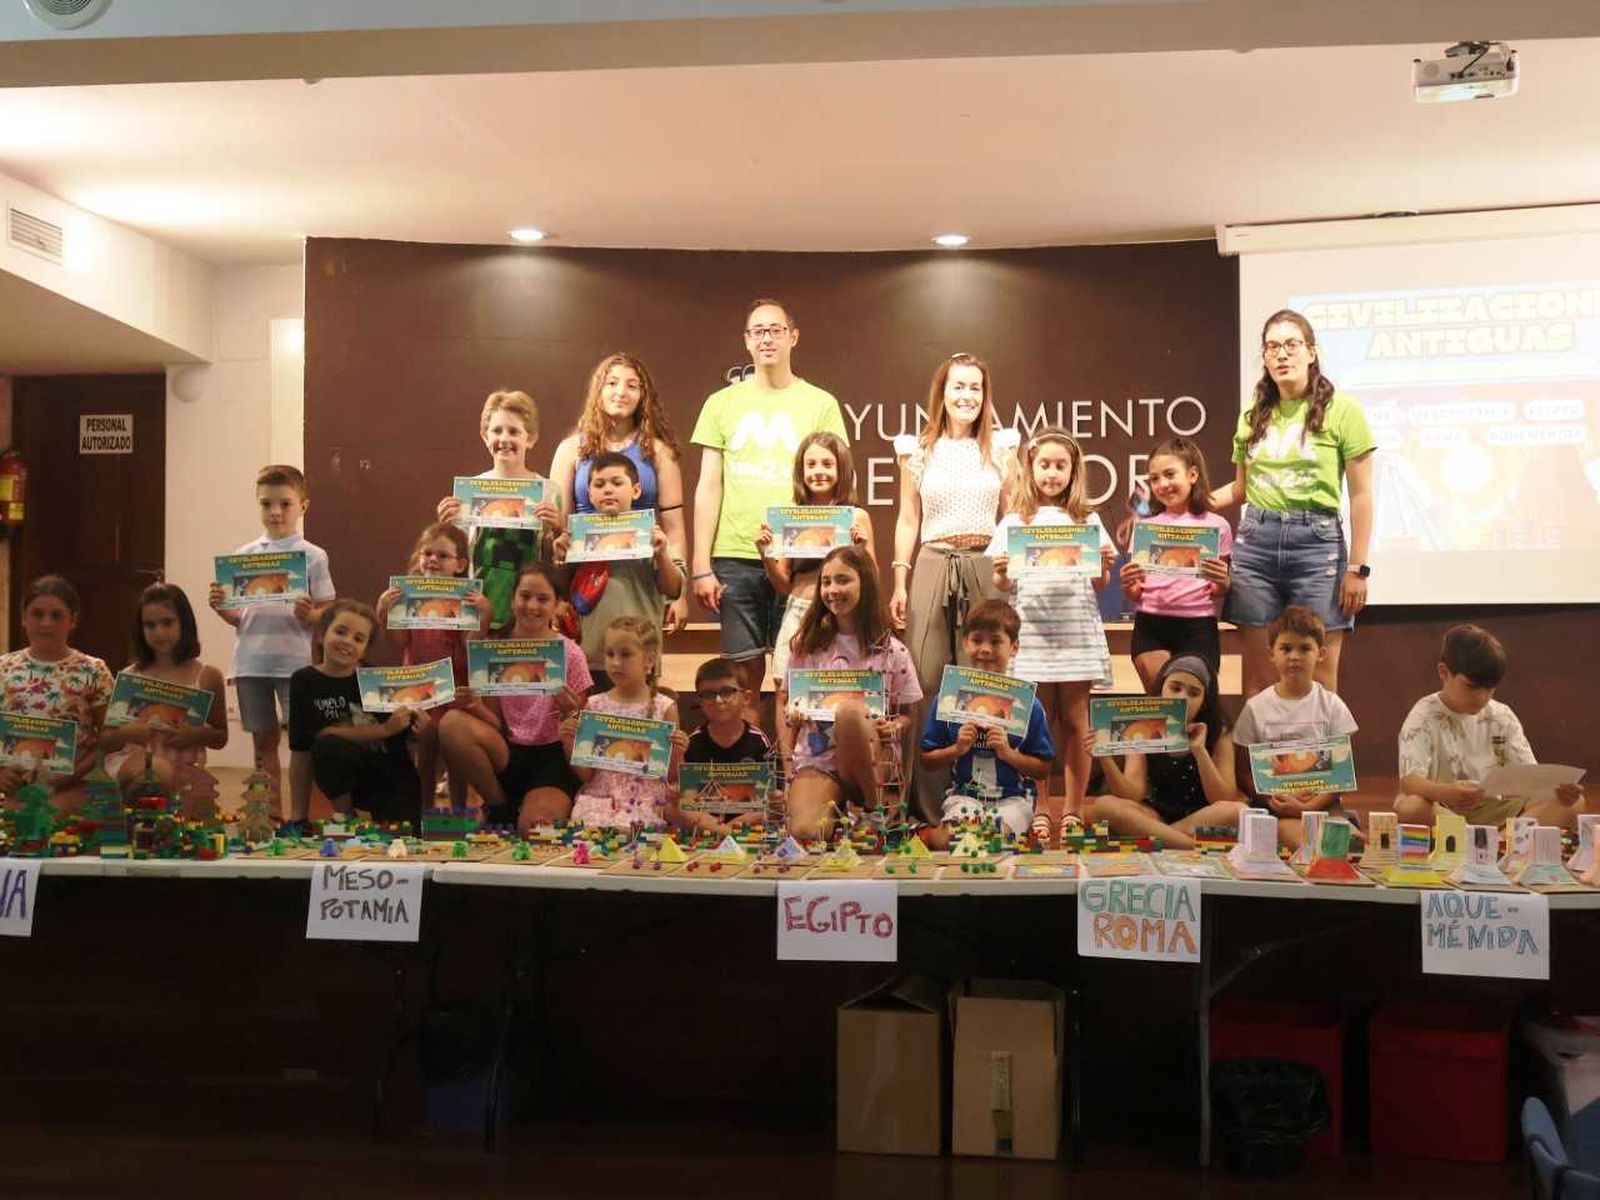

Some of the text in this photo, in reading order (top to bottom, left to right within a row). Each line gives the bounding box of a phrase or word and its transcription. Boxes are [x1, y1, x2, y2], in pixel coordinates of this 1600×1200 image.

[1366, 320, 1575, 359] ANTIGUAS
[86, 418, 127, 431] PERSONAL
[81, 436, 131, 450] AUTORIZADO
[322, 864, 409, 891] MESO-
[320, 898, 409, 924] POTAMIA
[784, 895, 894, 938] EGIPTO
[1080, 880, 1196, 922] GRECIA
[1093, 911, 1198, 954] ROMA
[1427, 919, 1539, 955] MÉNIDA
